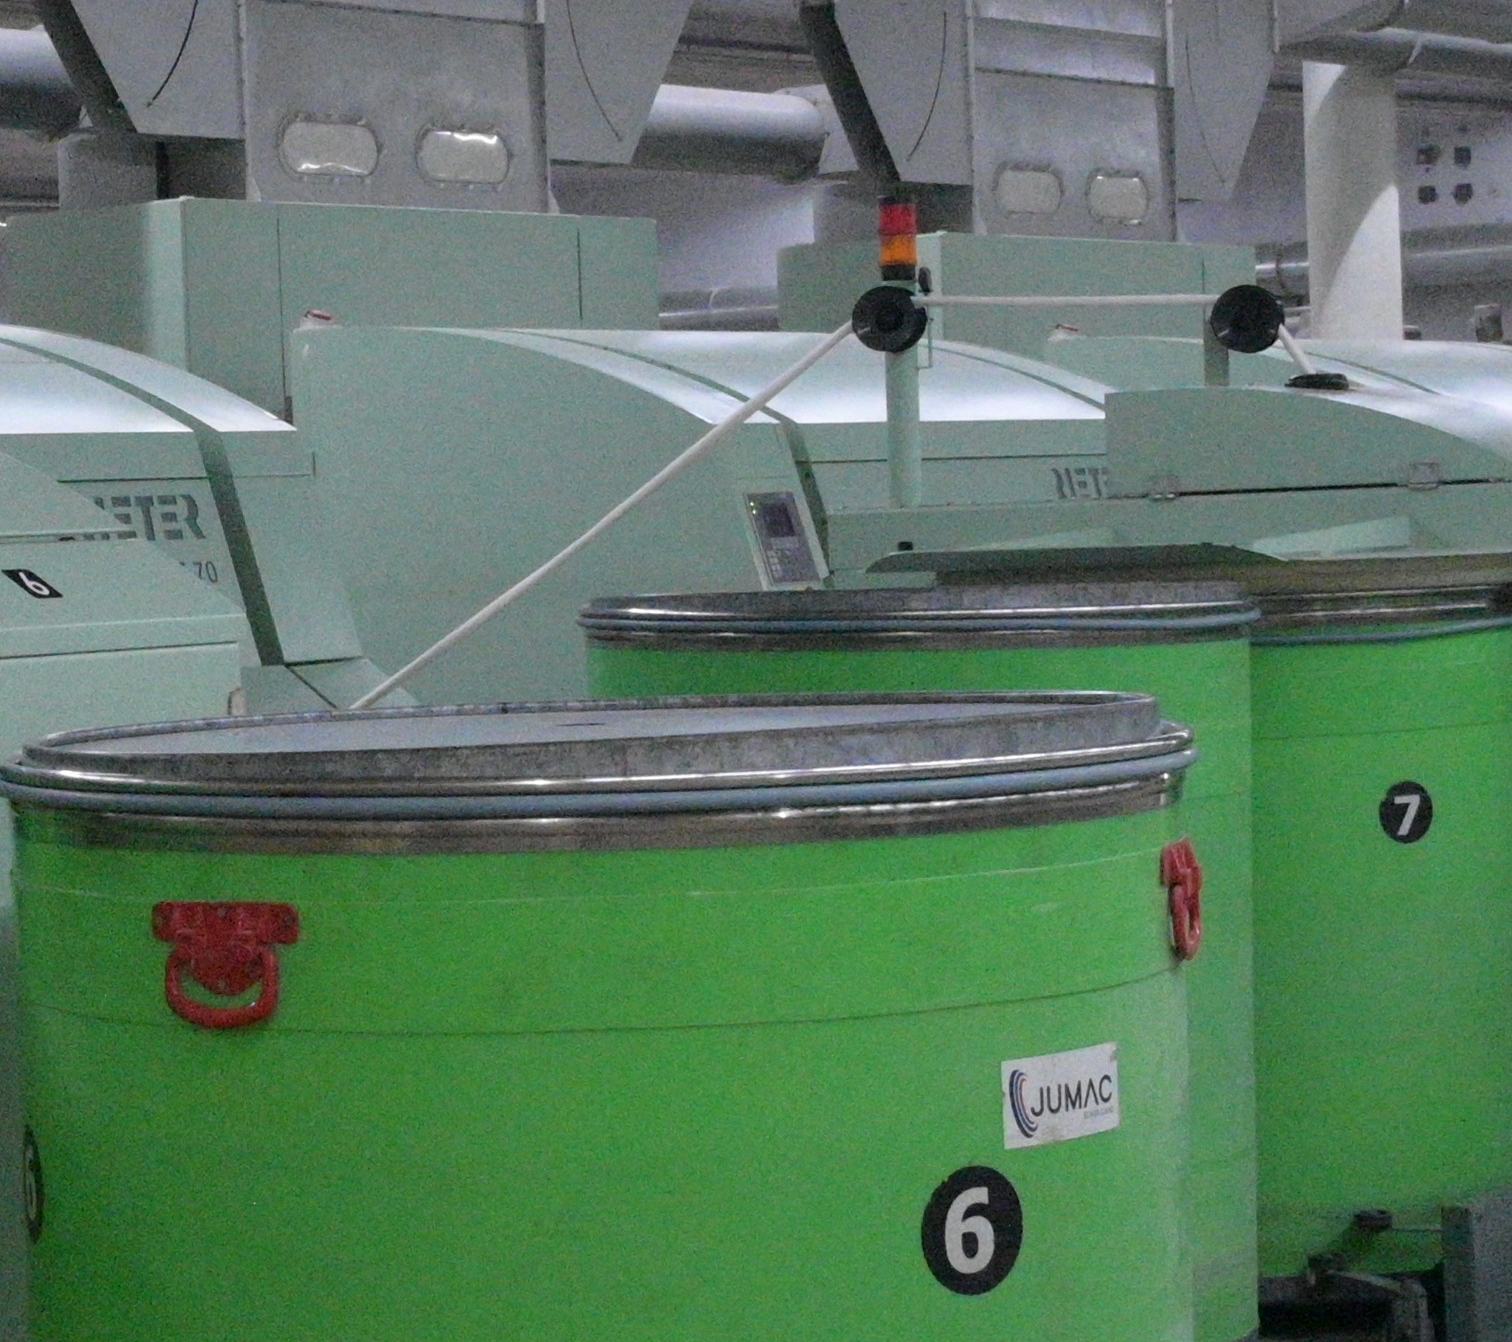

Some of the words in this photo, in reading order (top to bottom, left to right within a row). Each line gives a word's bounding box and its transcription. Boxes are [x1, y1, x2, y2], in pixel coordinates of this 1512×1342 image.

[1394, 794, 1420, 836] 7
[1030, 1074, 1113, 1117] JUMAC
[944, 1186, 996, 1274] 6
